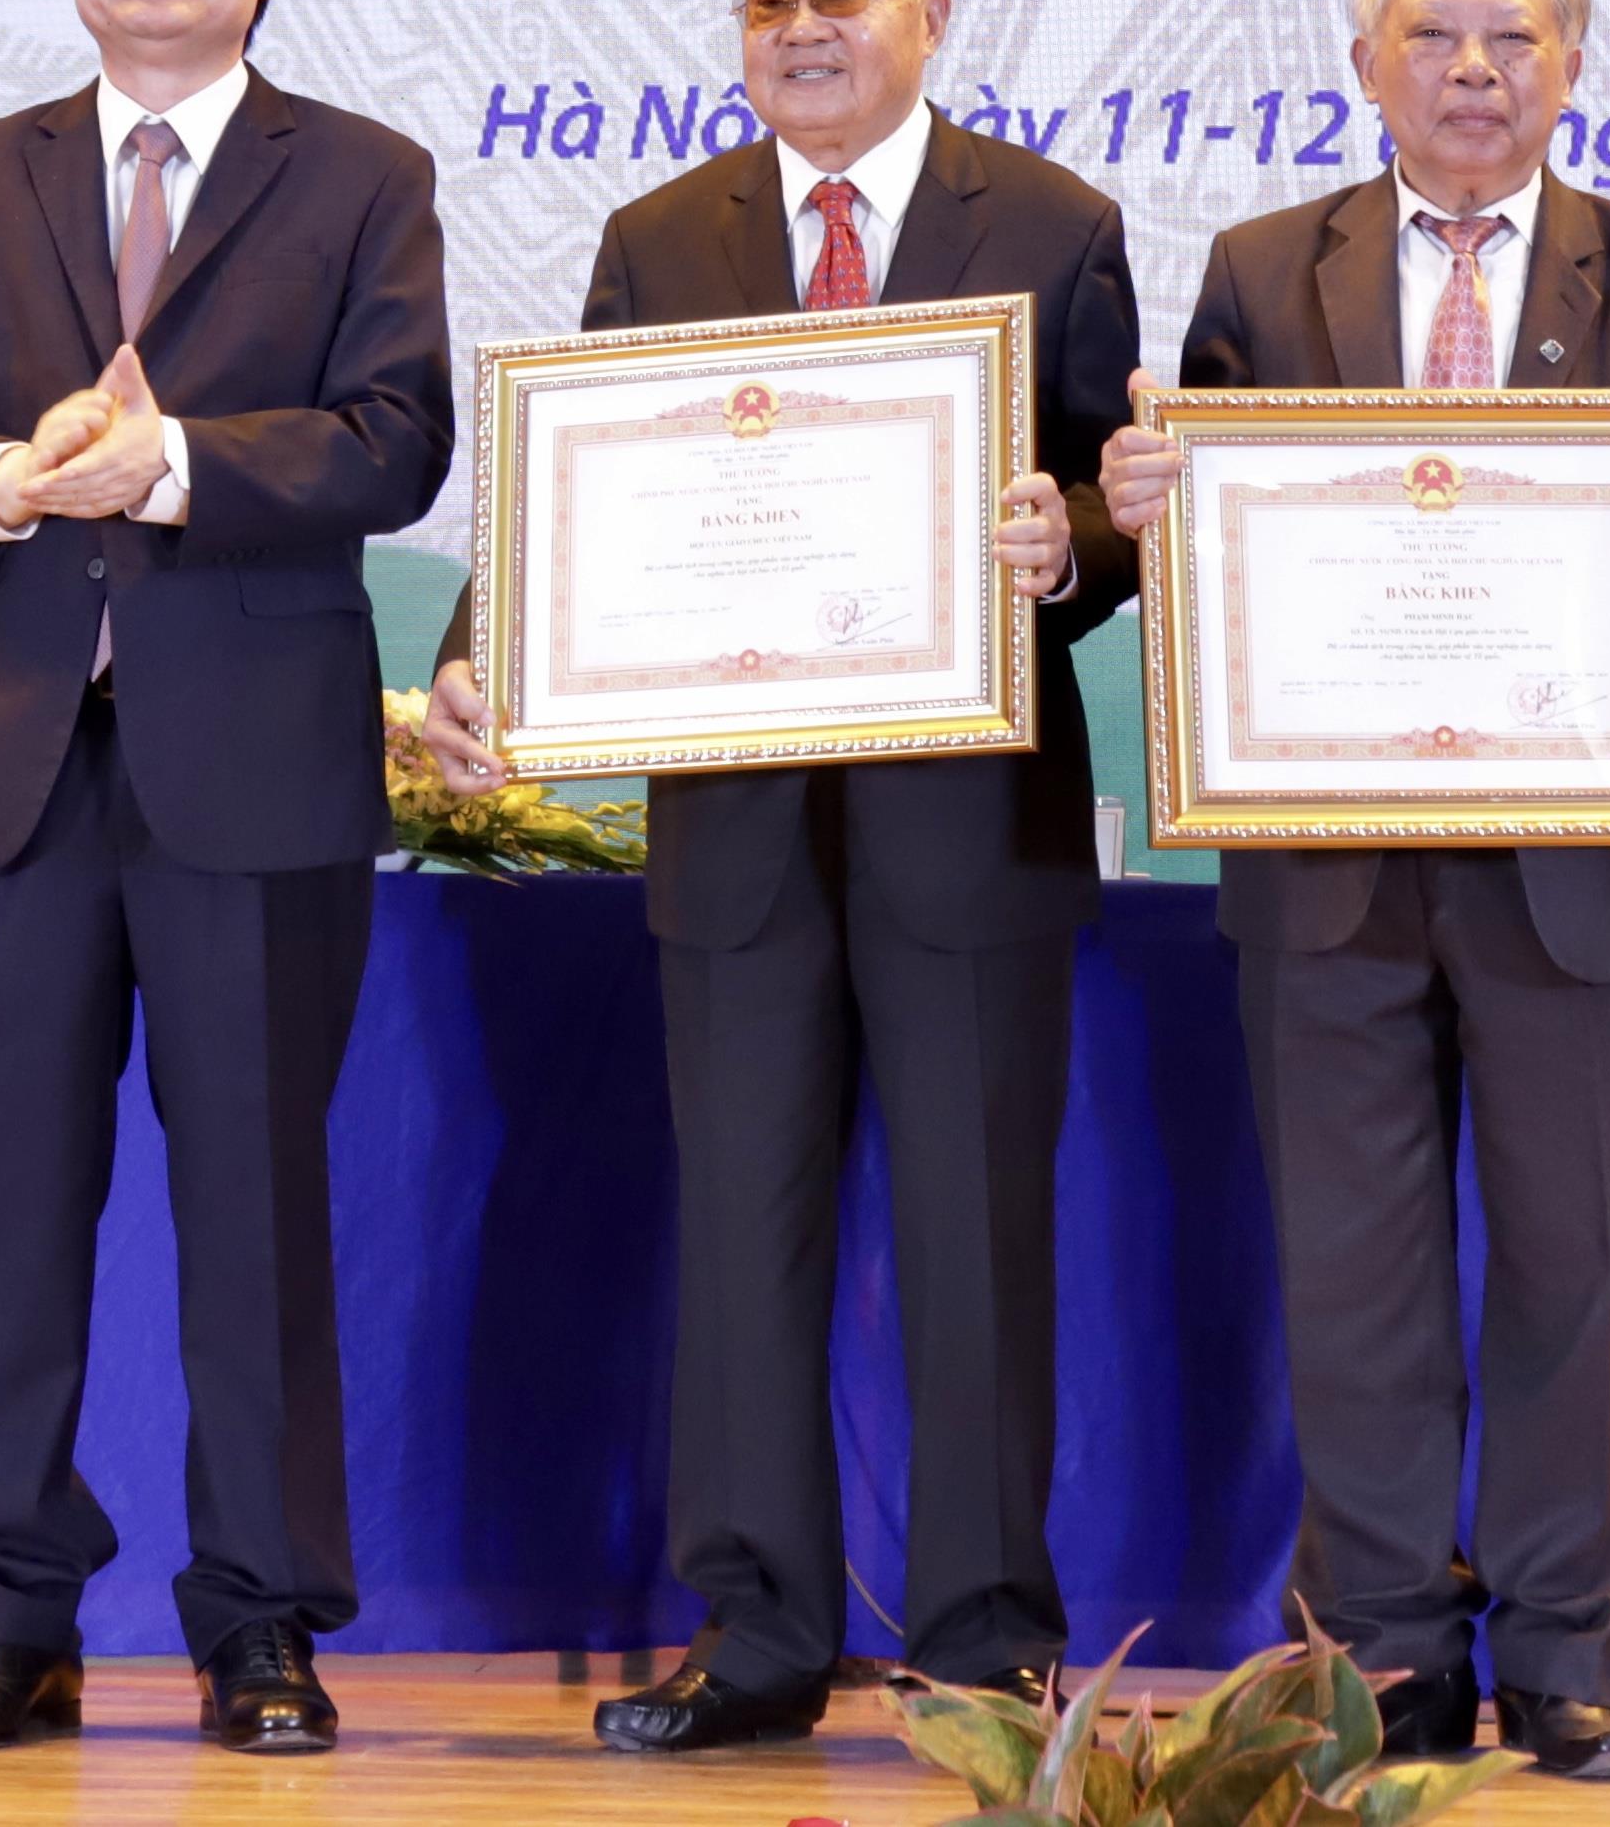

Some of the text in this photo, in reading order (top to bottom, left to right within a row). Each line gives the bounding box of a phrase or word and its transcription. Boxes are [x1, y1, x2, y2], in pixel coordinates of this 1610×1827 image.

[478, 80, 604, 160] Hà
[1103, 89, 1351, 166] 11-12
[753, 508, 803, 525] KHEN
[1441, 586, 1492, 600] KHEN
